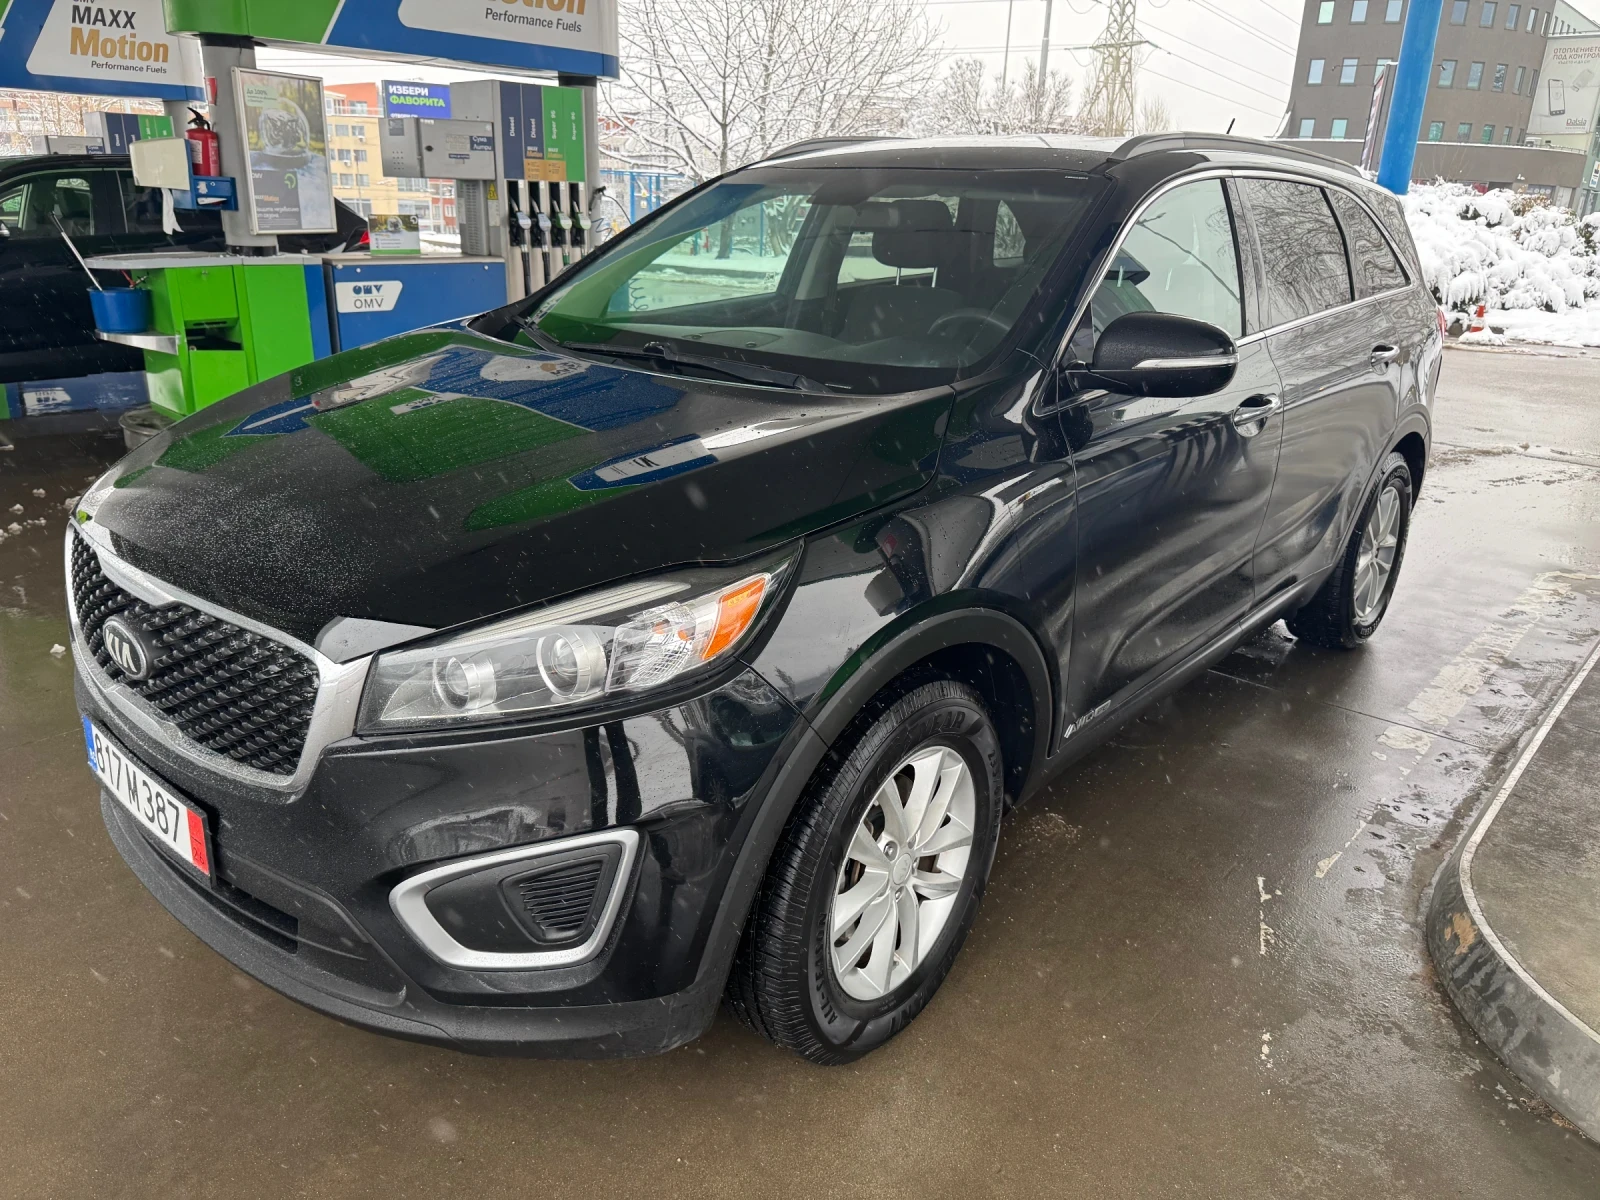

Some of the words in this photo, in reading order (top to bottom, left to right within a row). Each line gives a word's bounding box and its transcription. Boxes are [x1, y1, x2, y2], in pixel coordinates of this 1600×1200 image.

[71, 4, 136, 30] MAXX
[485, 7, 553, 29] Performance
[556, 18, 582, 33] Fuels
[70, 26, 169, 63] Motion
[91, 60, 144, 72] Performance
[146, 65, 167, 74] Fuels
[388, 85, 428, 96] ИЗБЕРИ
[390, 95, 446, 107] ФАВОРИТА
[354, 298, 384, 309] OMV
[105, 630, 138, 673] KIA
[94, 734, 121, 791] 817
[126, 764, 140, 812] M
[142, 780, 180, 842] 387
[814, 912, 838, 1025] ALL-SEASON
